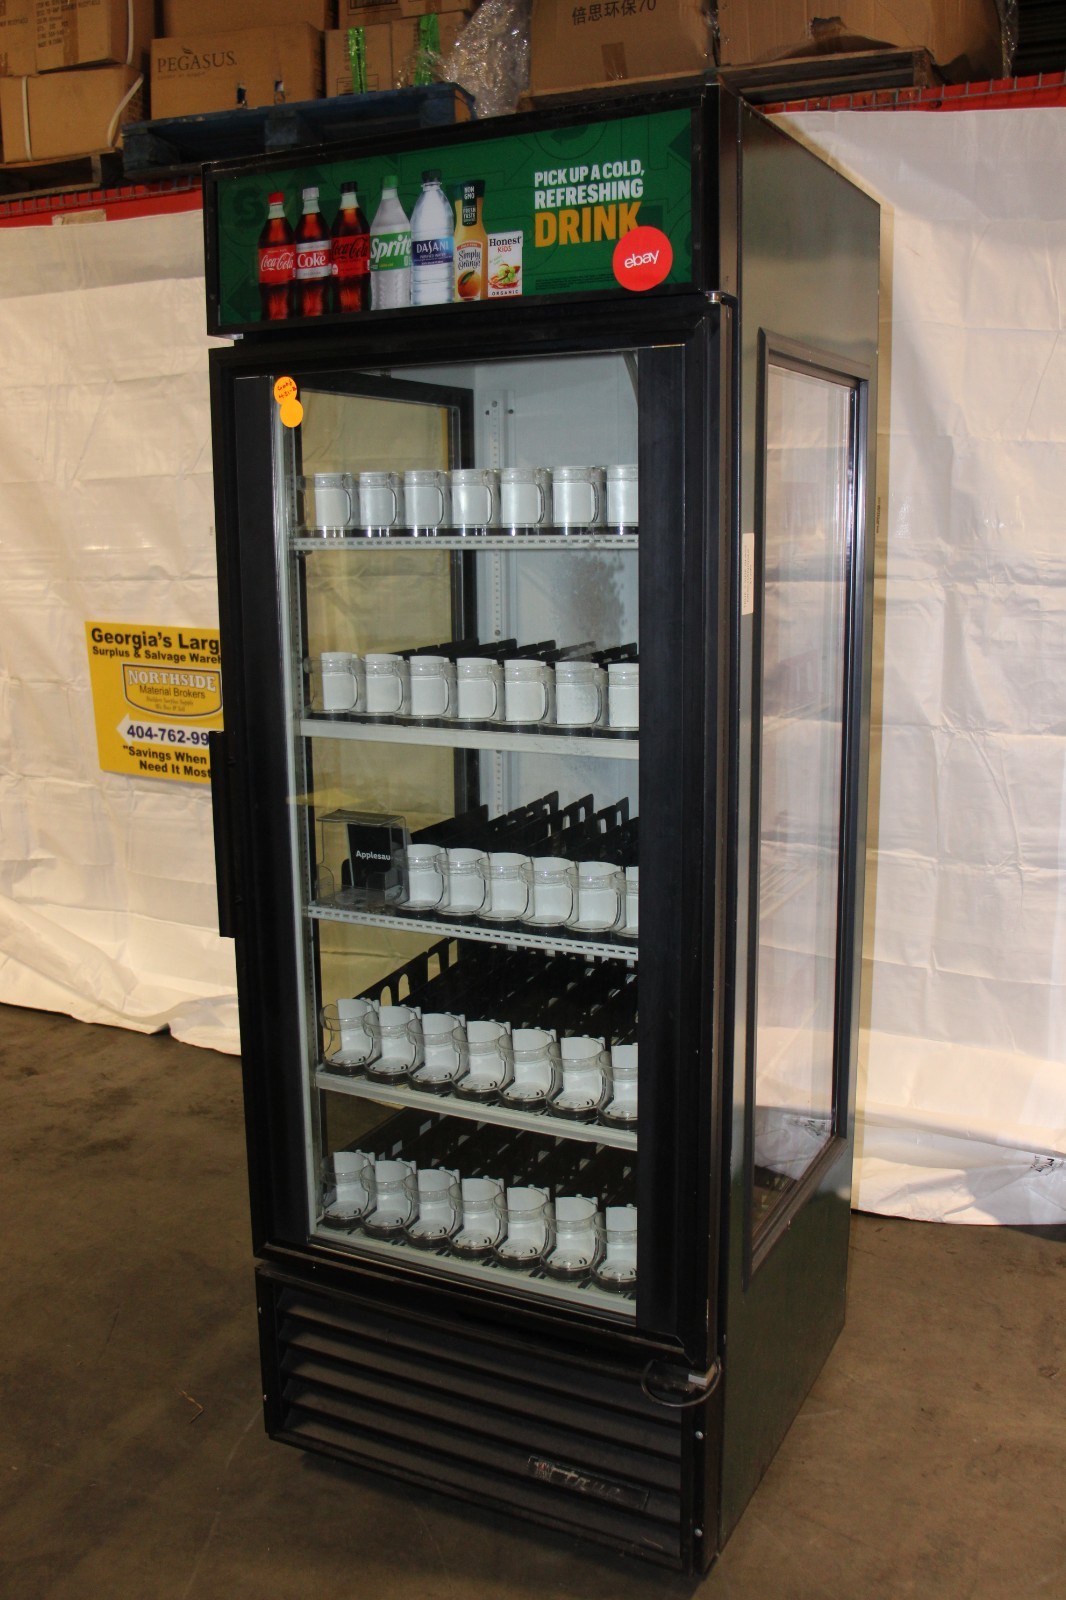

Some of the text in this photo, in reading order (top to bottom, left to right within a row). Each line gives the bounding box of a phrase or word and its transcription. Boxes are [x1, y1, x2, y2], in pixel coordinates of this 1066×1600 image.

[535, 159, 645, 187] PICK UP A COLD,
[535, 178, 644, 209] REFRESHING
[535, 201, 641, 248] DRINK
[370, 234, 412, 263] Sprite
[416, 240, 449, 254] DASANI
[489, 237, 520, 247] Honest
[260, 252, 294, 272] Coca-Cola
[297, 252, 326, 268] Coke
[458, 249, 481, 261] Simply
[624, 250, 660, 269] ebay
[91, 628, 219, 655] Georgia's Larg
[92, 646, 130, 659] Surplus
[133, 648, 141, 658] &
[144, 650, 186, 663] Salvage
[128, 669, 216, 692] NORTHSIDE
[139, 685, 206, 699] Material Brokers
[174, 751, 207, 764] When
[139, 760, 211, 779] Need It Most
